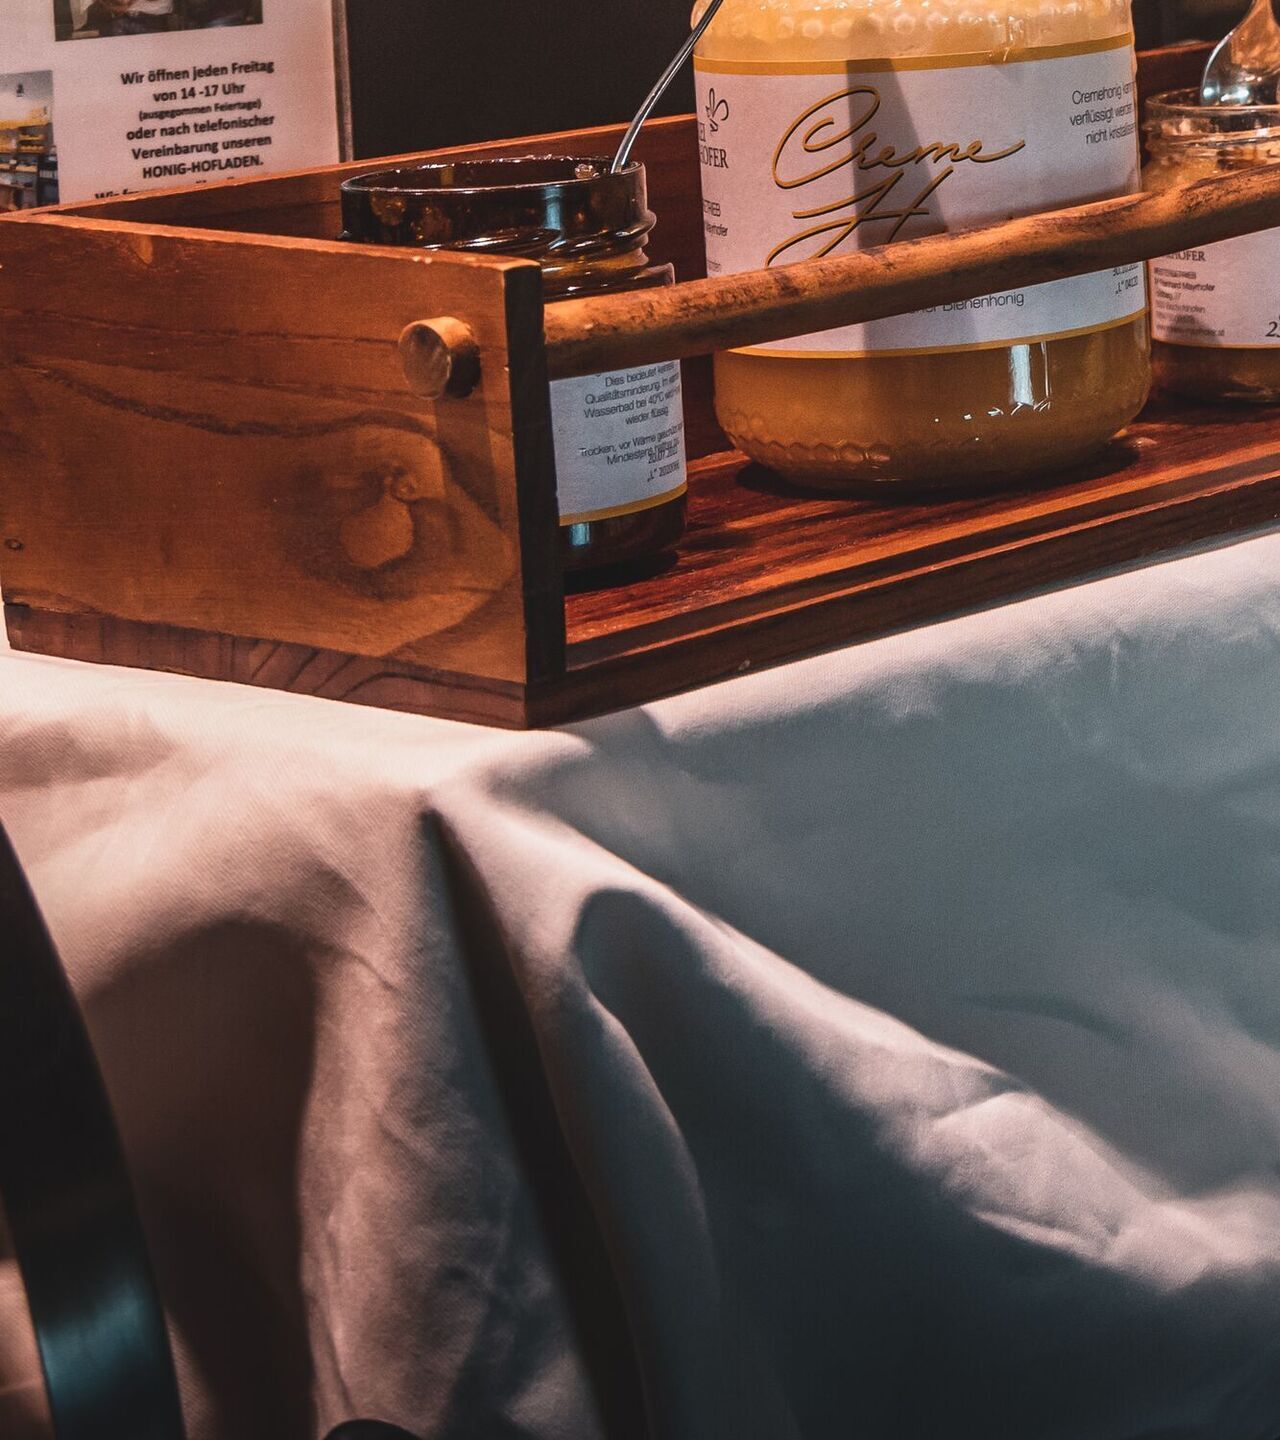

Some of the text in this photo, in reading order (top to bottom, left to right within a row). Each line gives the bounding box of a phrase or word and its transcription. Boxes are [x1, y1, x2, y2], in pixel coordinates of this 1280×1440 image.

[121, 61, 275, 85] Wir öffnen jeden Freitag
[153, 90, 177, 102] von
[180, 87, 196, 100] 14
[222, 82, 245, 95] Uhr
[126, 114, 275, 141] oder nach telefonischer
[132, 135, 272, 160] Vereinbarung unseren
[142, 154, 264, 179] HONIG-HOFLADEN.
